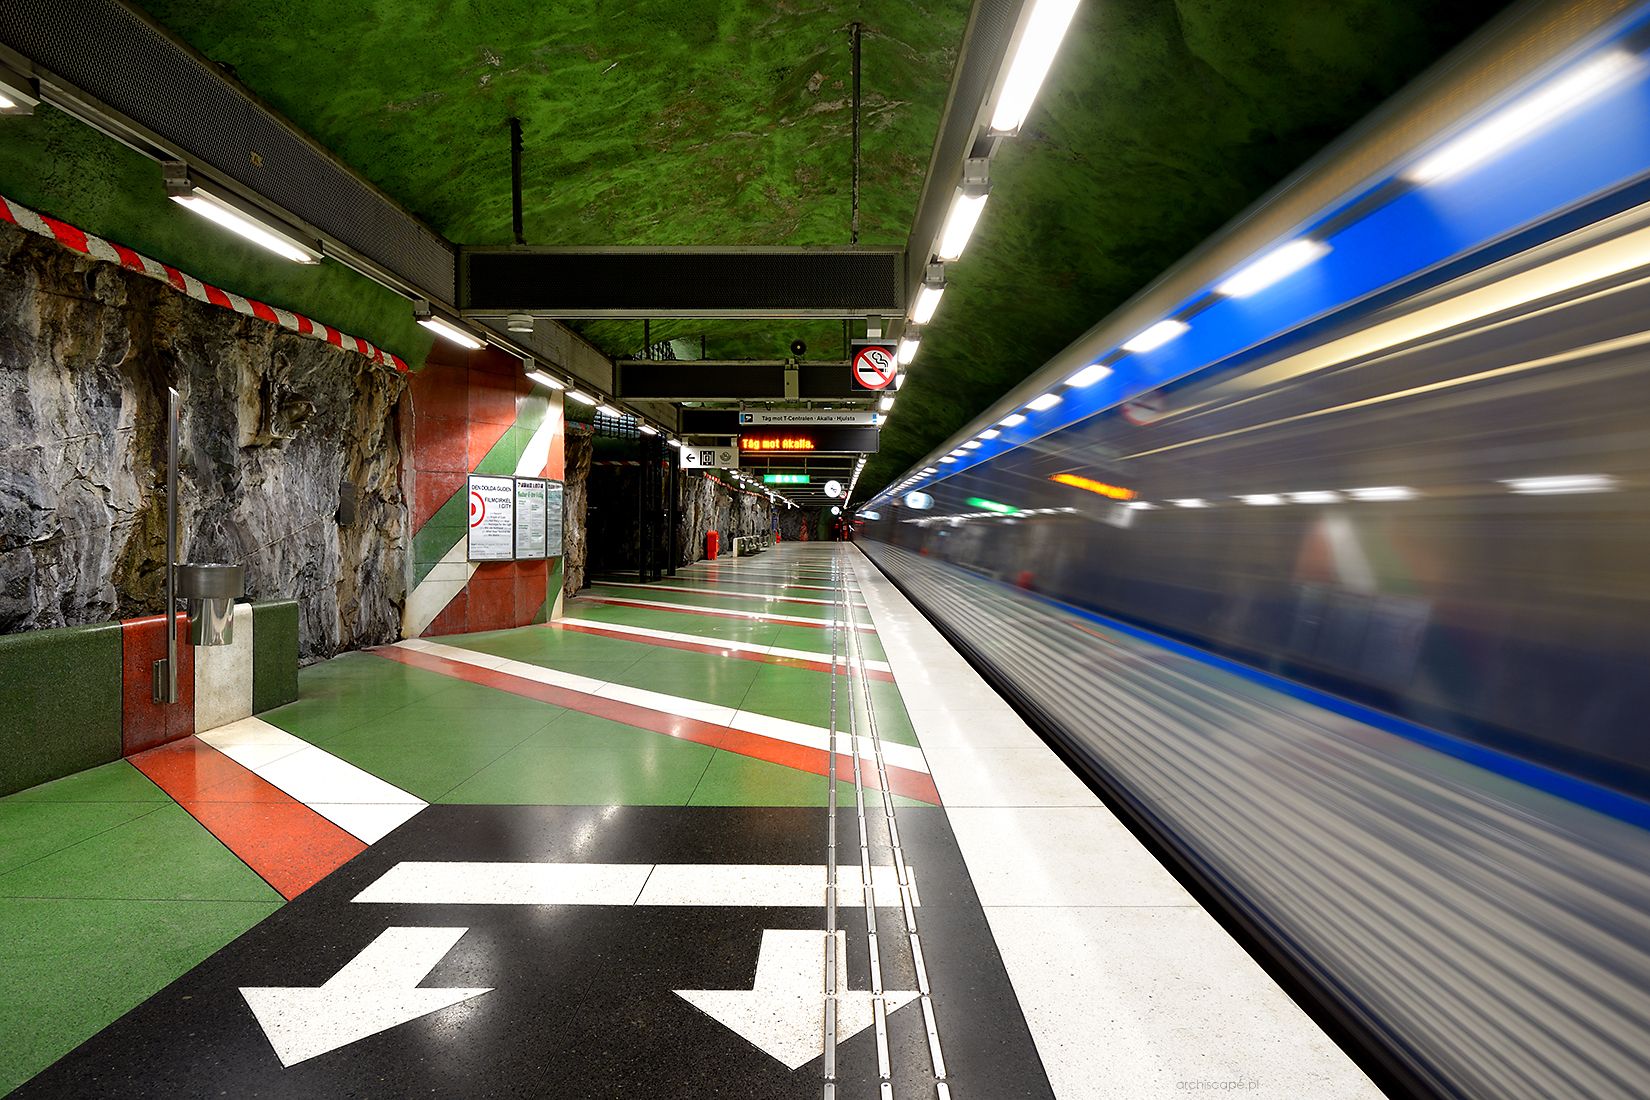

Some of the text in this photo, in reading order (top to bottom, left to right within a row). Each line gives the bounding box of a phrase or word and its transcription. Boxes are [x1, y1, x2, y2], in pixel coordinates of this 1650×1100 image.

[742, 438, 814, 449] Tåg mot Akalla.
